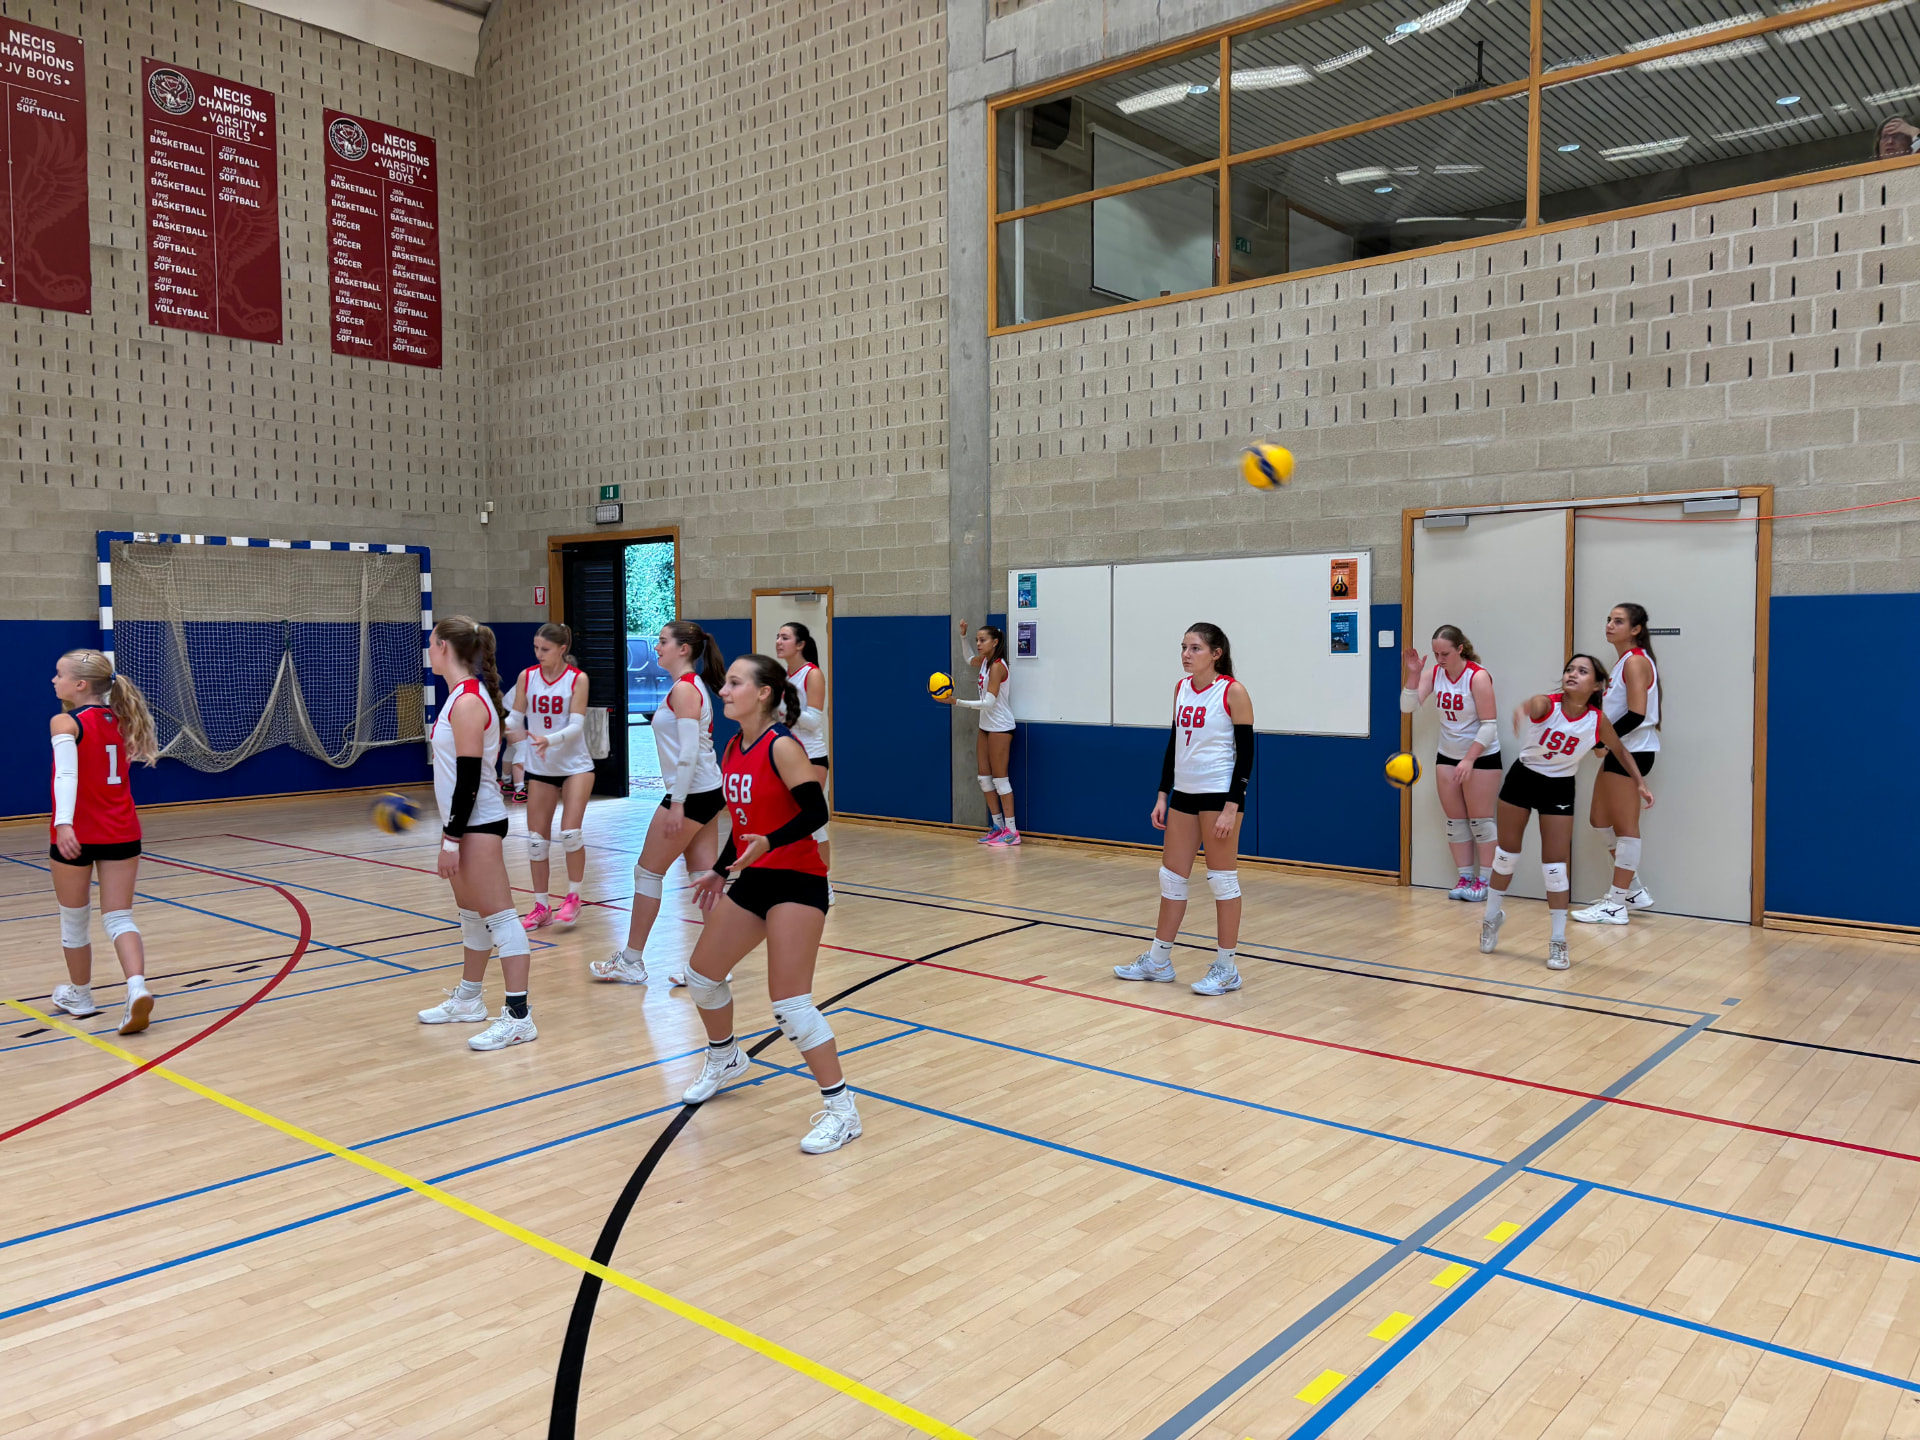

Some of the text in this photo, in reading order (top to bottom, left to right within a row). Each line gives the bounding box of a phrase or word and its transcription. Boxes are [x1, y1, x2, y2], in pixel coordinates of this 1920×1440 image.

[10, 30, 56, 53] NECIS
[0, 42, 74, 72] HAMPIONS
[6, 62, 62, 85] JV BOYS
[20, 96, 38, 106] 2022
[214, 86, 252, 106] NECIS
[16, 102, 66, 122] SOFTBALL
[198, 96, 267, 122] CHAMPIONS
[209, 112, 257, 132] VARSITY
[216, 125, 251, 142] GIRLS
[150, 136, 205, 155] BASKETBALL
[384, 132, 417, 152] NECIS
[218, 152, 260, 168] SOFTBALL
[372, 142, 430, 166] CHAMPIONS
[150, 156, 205, 176] BASKETBALL
[380, 157, 421, 176] VARSITY
[219, 173, 260, 188] SOFTBALL
[389, 170, 414, 184] BOYS
[151, 178, 206, 196] BASKETBALL
[331, 180, 378, 197] BASKETBALL
[152, 199, 207, 217] BASKETBALL
[218, 193, 260, 208] SOFTBALL
[331, 199, 378, 216] BASKETBALL
[390, 195, 424, 209] SOFTBALL
[152, 220, 208, 237] BASKETBALL
[332, 218, 360, 231] SOCCER
[390, 213, 434, 229] BASKETBALL
[333, 238, 361, 250] SOCCER
[391, 232, 425, 246] SOFTBALL
[153, 241, 197, 256] SOFTBALL
[334, 257, 362, 269] SOCCER
[392, 251, 436, 266] BASKETBALL
[154, 262, 197, 276] SOFTBALL
[392, 270, 436, 284] BASKETBALL
[154, 283, 198, 297] SOFTBALL
[335, 276, 381, 292] BASKETBALL
[336, 295, 382, 310] BASKETBALL
[393, 288, 437, 302] BASKETBALL
[154, 304, 209, 320] VOLLEYBALL
[336, 314, 365, 326] SOCCER
[394, 306, 428, 318] SOFTBALL
[393, 325, 428, 336] SOFTBALL
[336, 334, 373, 346] SOFTBALL
[392, 343, 427, 355] SOFTBALL
[532, 694, 563, 714] ISB
[1436, 690, 1464, 710] ISB
[544, 716, 552, 729] 9
[1176, 705, 1207, 728] ISB
[1444, 710, 1458, 722] 11
[1185, 730, 1192, 746] 7
[1539, 727, 1580, 756] ISB
[105, 744, 122, 785] 1
[722, 772, 752, 804] ISB
[735, 808, 748, 826] 3
